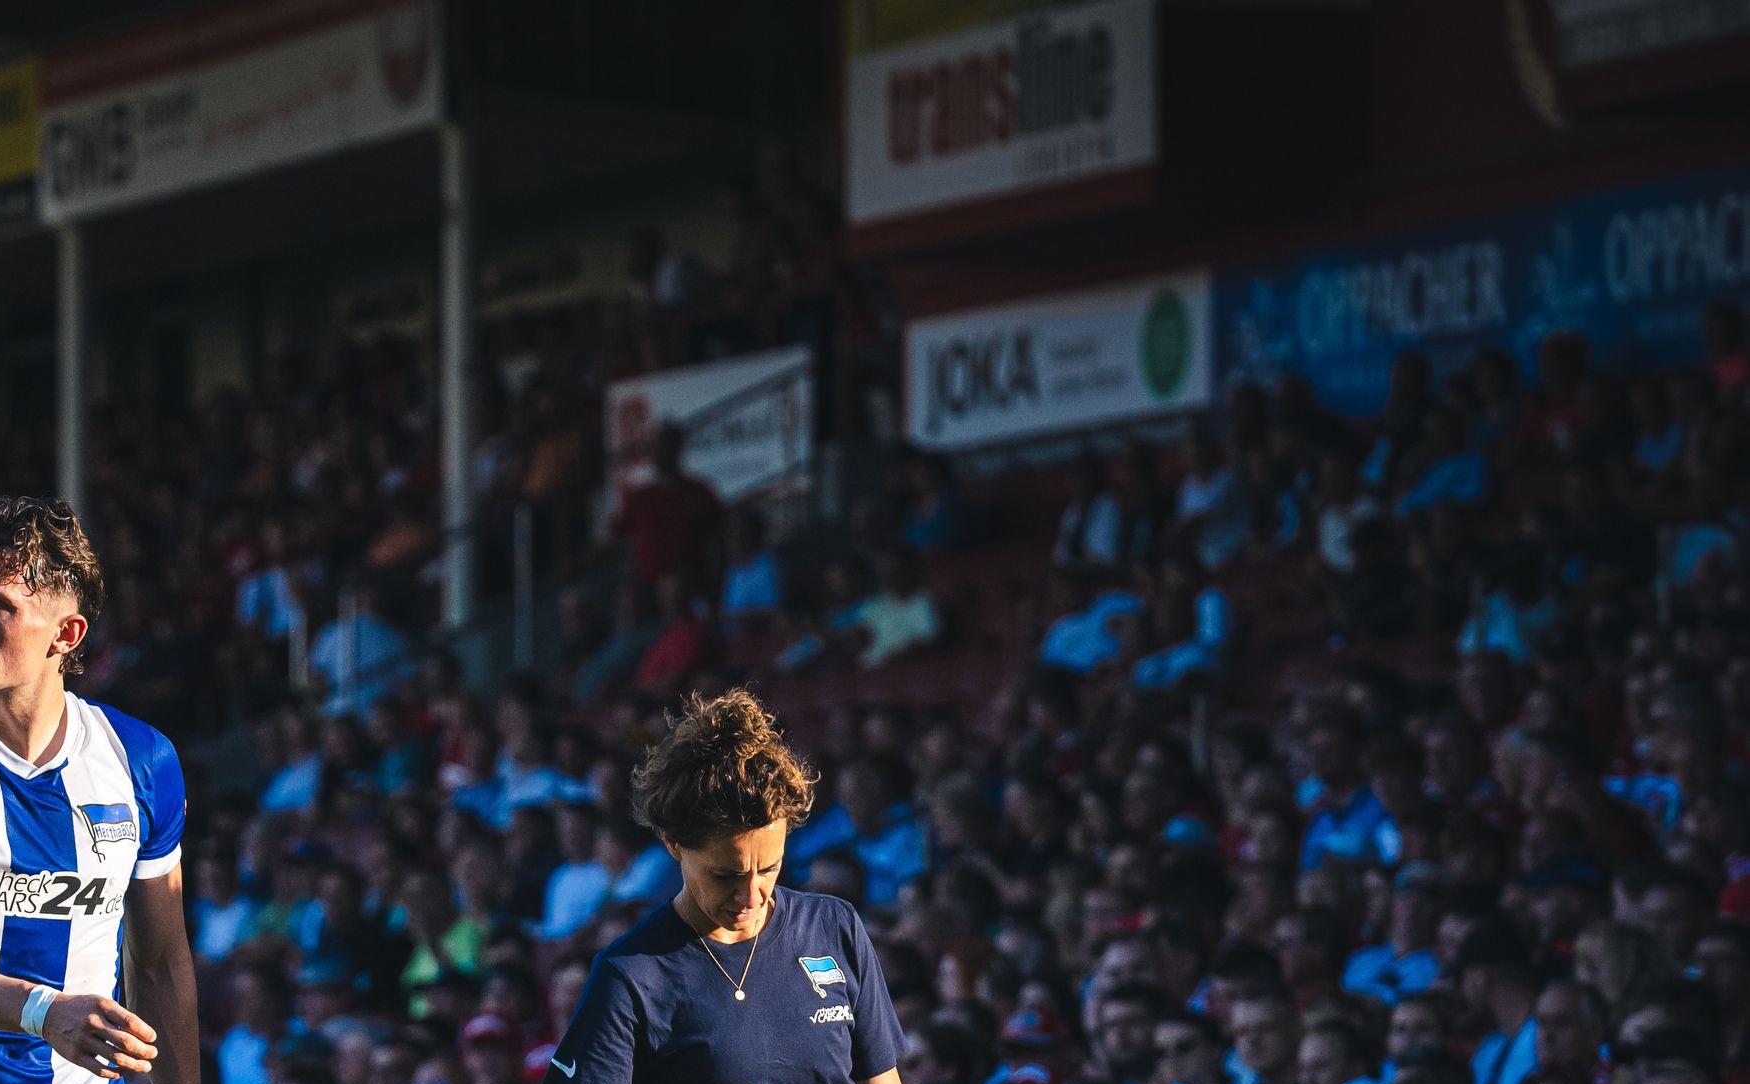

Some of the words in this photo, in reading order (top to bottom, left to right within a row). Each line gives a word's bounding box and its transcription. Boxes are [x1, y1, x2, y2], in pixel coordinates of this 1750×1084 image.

[928, 325, 1041, 436] JOKA
[94, 826, 122, 839] Hertha
[122, 822, 135, 838] BSC
